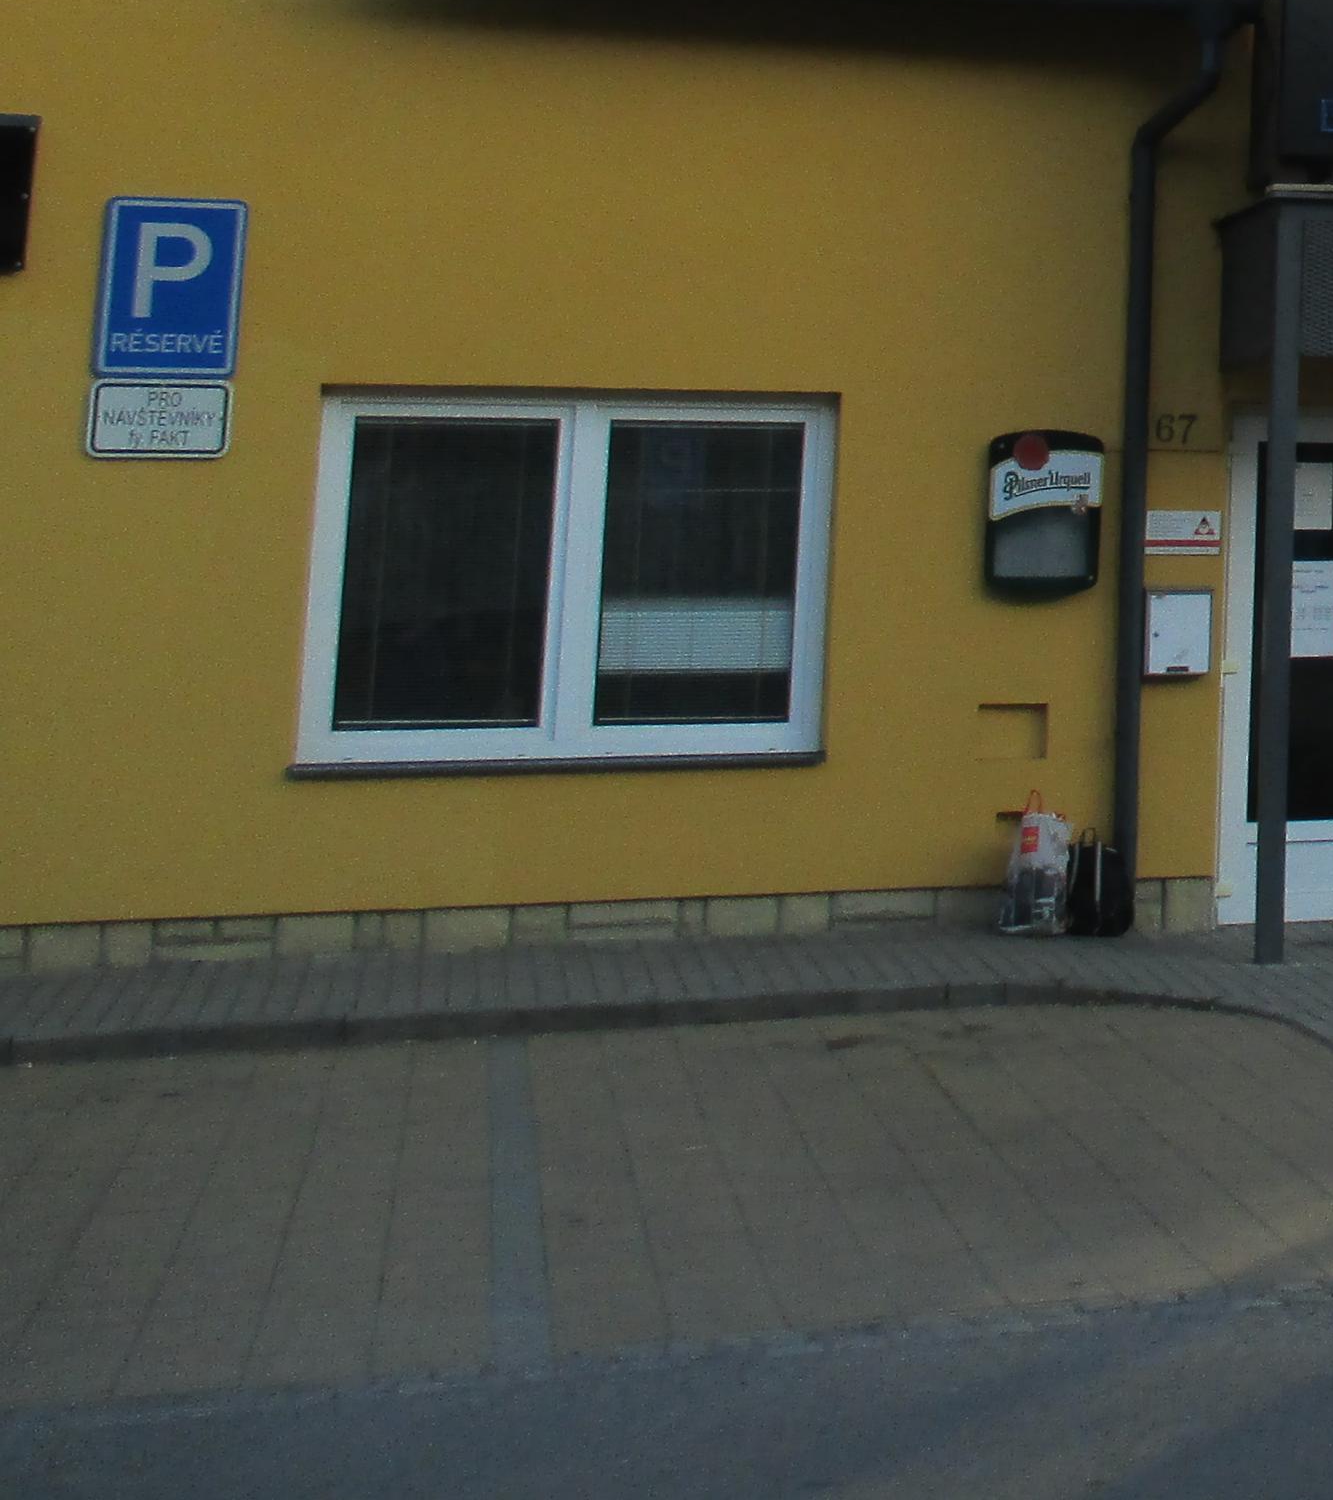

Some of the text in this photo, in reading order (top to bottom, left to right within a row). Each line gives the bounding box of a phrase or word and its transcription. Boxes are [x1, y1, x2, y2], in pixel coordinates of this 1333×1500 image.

[132, 222, 213, 318] P
[110, 328, 223, 353] RÉSERVÉ
[147, 391, 182, 407] PRO
[1156, 414, 1197, 444] 67
[1003, 470, 1091, 501] Pilsner Urquell
